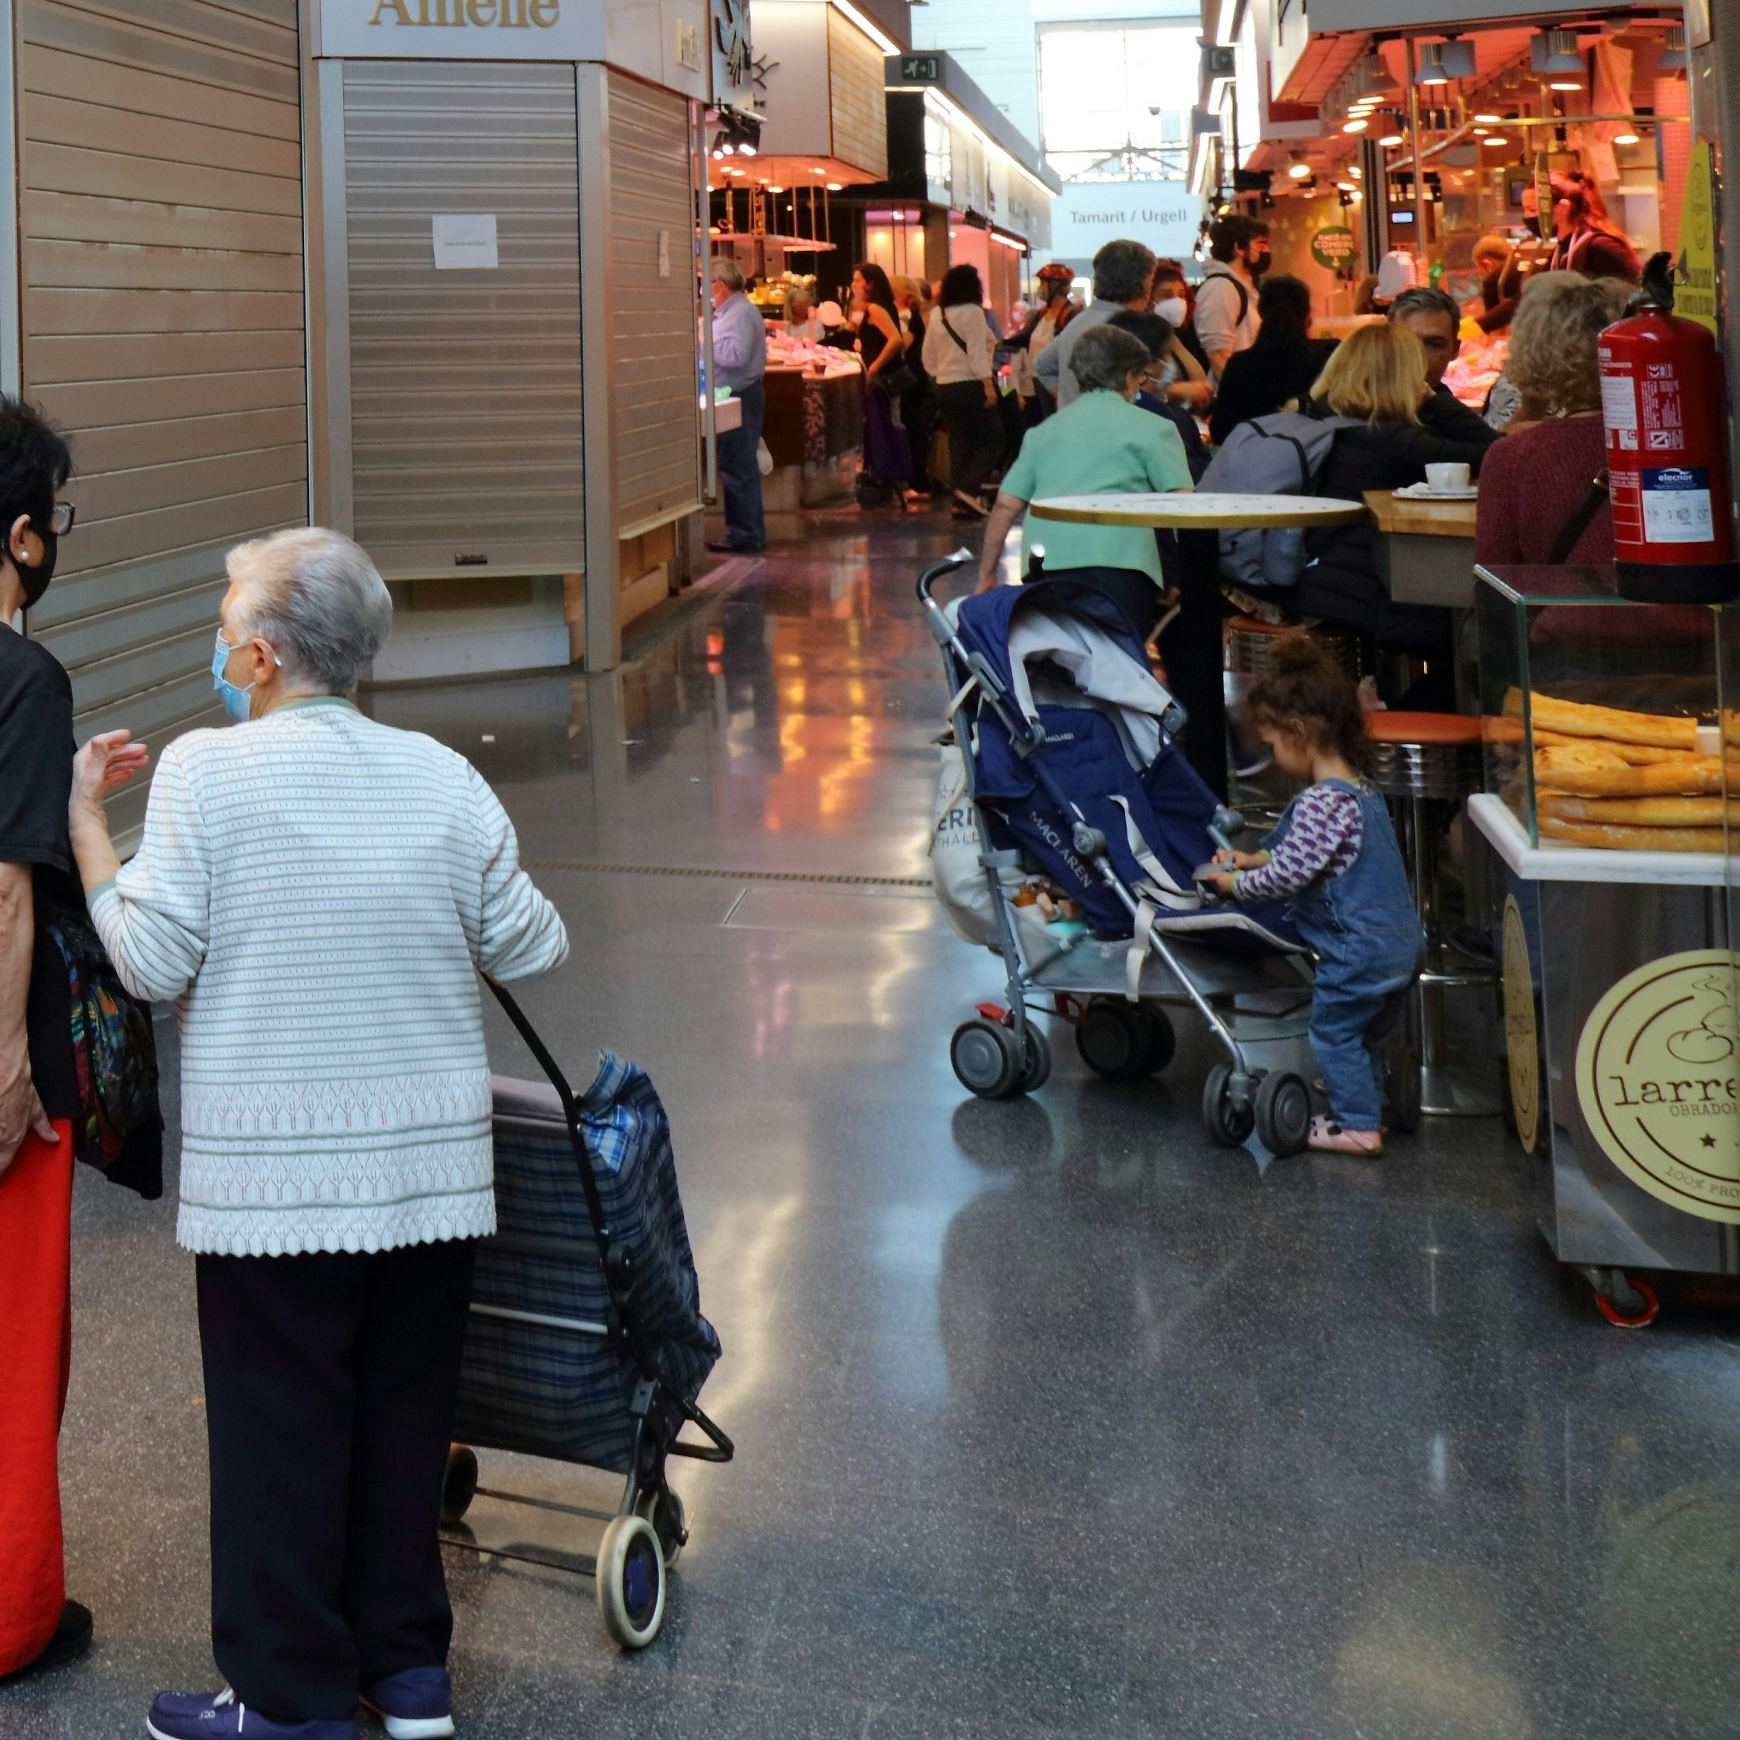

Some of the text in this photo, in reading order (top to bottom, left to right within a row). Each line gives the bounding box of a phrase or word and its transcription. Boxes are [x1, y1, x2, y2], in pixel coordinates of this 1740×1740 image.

[1070, 210, 1126, 223] Tamarit
[1142, 209, 1187, 225] Urgell
[1045, 732, 1075, 743] MACLAREN
[1030, 811, 1093, 888] MACLAREN
